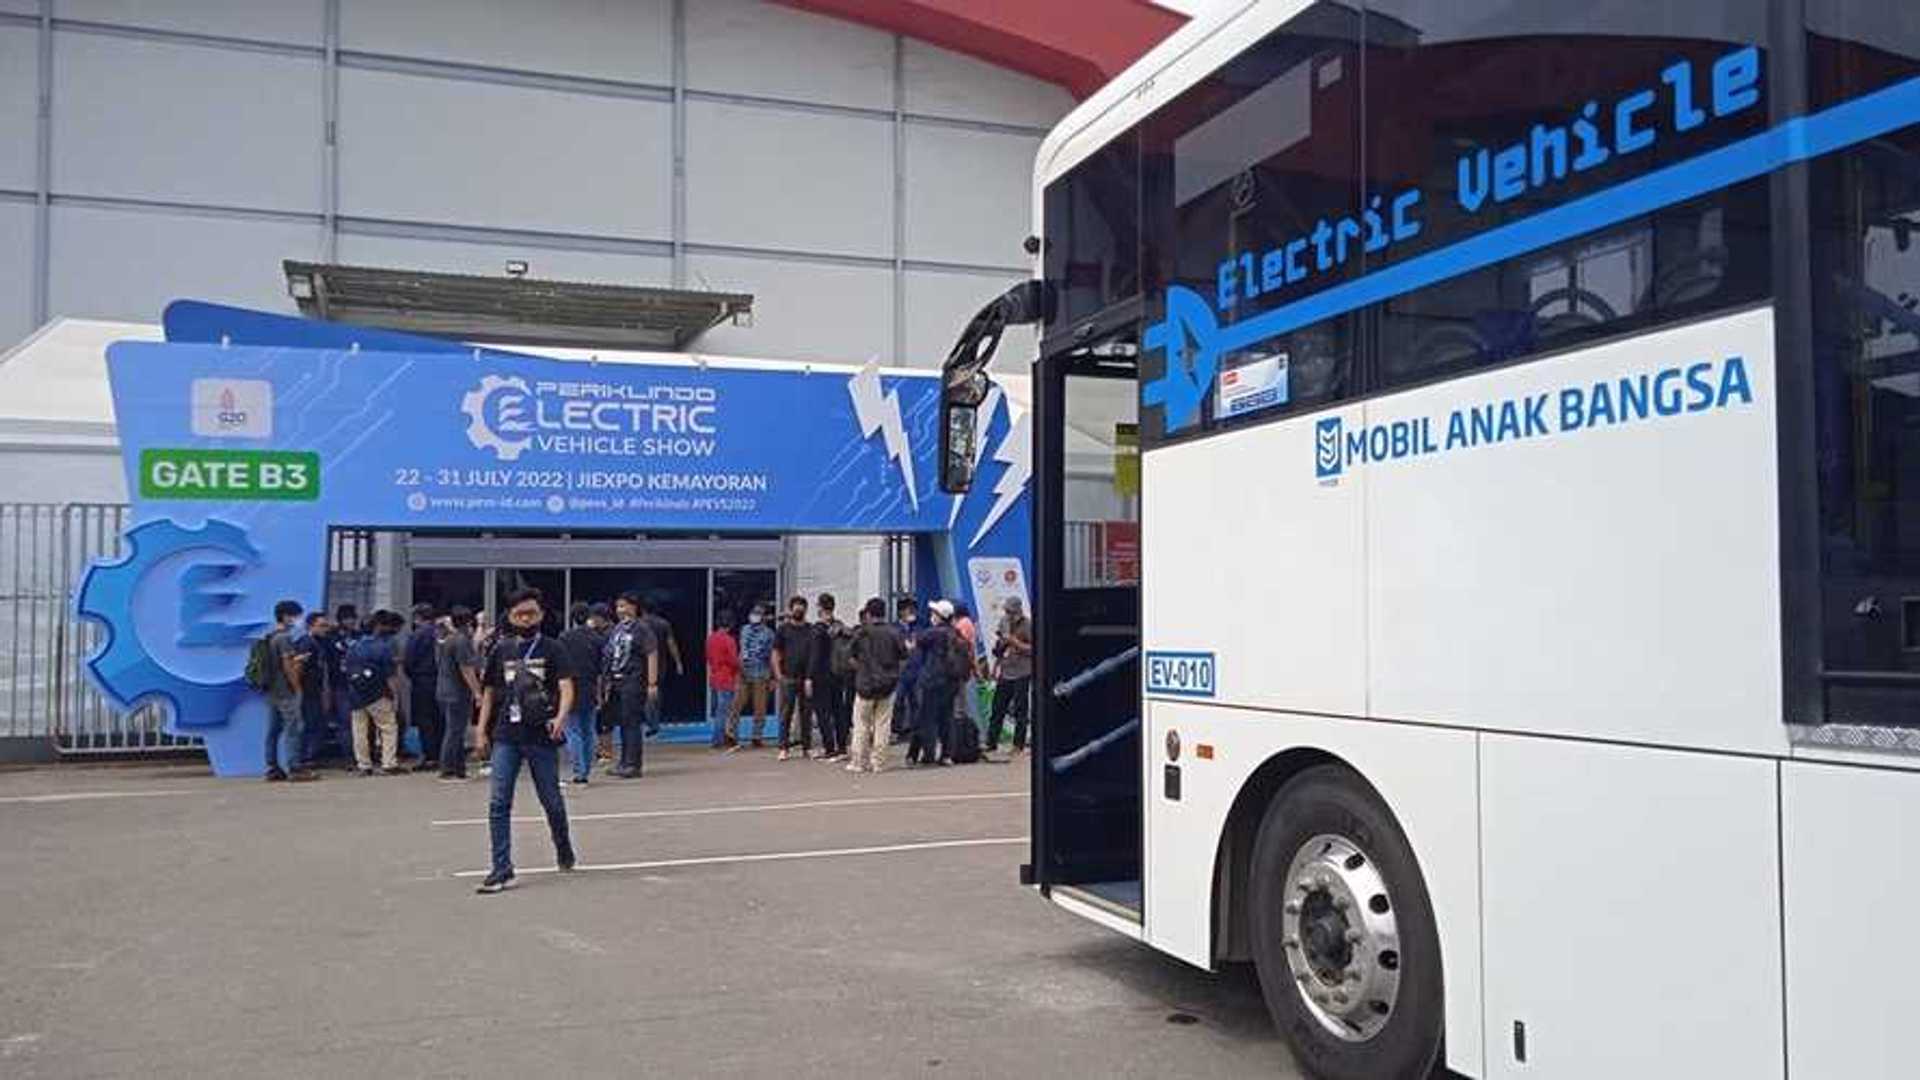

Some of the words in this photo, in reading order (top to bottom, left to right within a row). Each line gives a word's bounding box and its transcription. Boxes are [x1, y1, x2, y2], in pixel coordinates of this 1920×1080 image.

[1217, 188, 1422, 313] Electric
[1457, 44, 1759, 213] Vehicle
[535, 381, 716, 401] PERIKLINDO
[1346, 416, 1437, 466] MOBIL
[1446, 392, 1551, 451] ANAK
[1559, 356, 1752, 432] BANGSA
[537, 435, 637, 455] VEHICLE
[643, 438, 716, 457] SHOW
[151, 461, 250, 489] GATE
[258, 463, 308, 490] B3
[395, 468, 420, 486] 22
[437, 468, 461, 486] 31
[465, 469, 513, 487] JULY
[516, 470, 564, 488] 2022
[576, 471, 644, 489] JIEXPO
[648, 473, 768, 491] KEMAYORAN
[1151, 659, 1211, 688] EV-010
